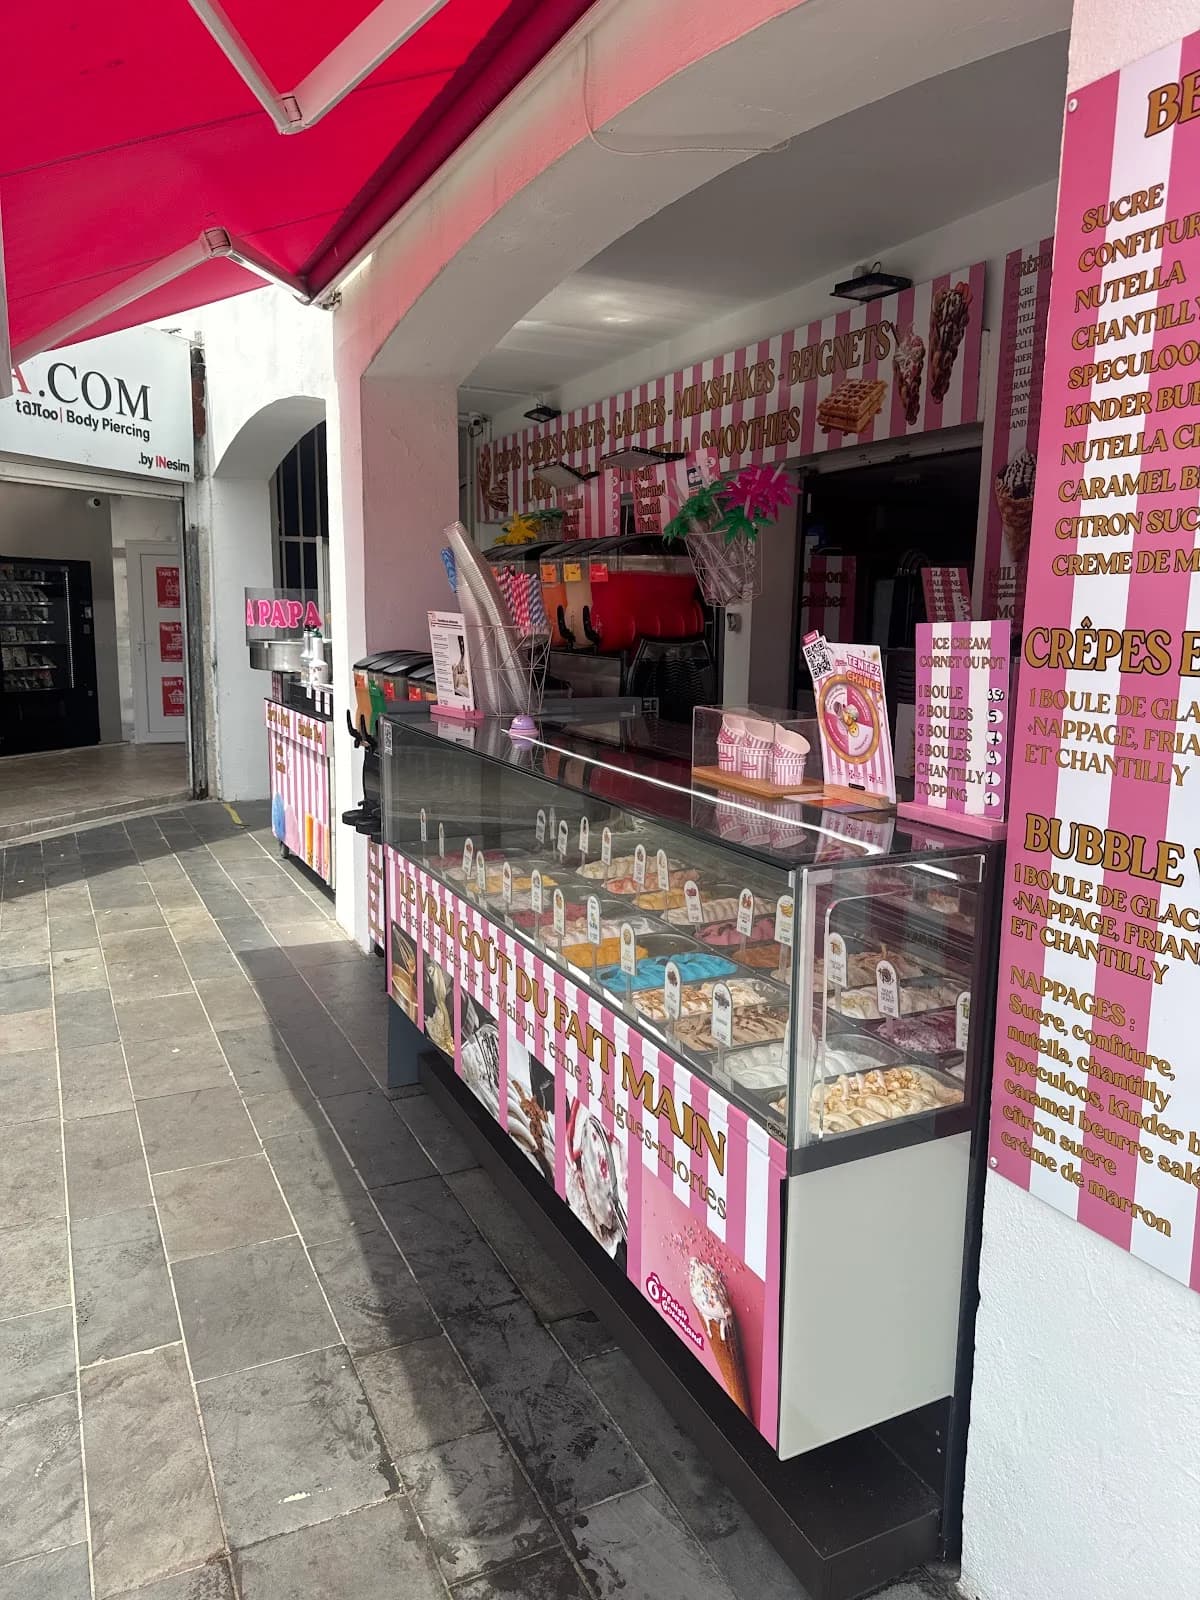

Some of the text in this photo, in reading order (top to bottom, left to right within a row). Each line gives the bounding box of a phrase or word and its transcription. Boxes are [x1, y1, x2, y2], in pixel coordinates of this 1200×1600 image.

[1081, 183, 1164, 233] SUCRE
[1074, 260, 1186, 313] NUTELLA
[1071, 296, 1200, 350] CHANTILL
[614, 396, 666, 440] GAUFRES
[674, 358, 775, 420] MILKSHAKES
[787, 320, 892, 386] BEIGNETS
[1068, 340, 1200, 389] SPECULOO
[67, 410, 99, 432] Body
[102, 418, 150, 442] Piercing
[1064, 391, 1152, 428] KINDER
[702, 406, 800, 458] SMOOTHIES
[1060, 429, 1168, 465] NUTELLA
[156, 455, 190, 472] INesim
[636, 480, 666, 499] Normal
[1058, 465, 1200, 502] CARAMEL B
[1055, 506, 1200, 540] CITRON SUC
[1052, 552, 1132, 576] CREME
[1136, 550, 1170, 574] DE
[258, 600, 322, 628] PAPA
[933, 638, 992, 650] ICE CREAM
[1024, 616, 1172, 676] CRÊPES
[846, 670, 880, 693] CHANCE
[847, 654, 880, 677] TENTEZ
[919, 656, 1006, 670] CORNET OU POT
[918, 684, 922, 698] 1
[924, 686, 963, 700] BOULE
[1030, 688, 1036, 707] 1
[1039, 688, 1110, 714] BOULE
[1115, 694, 1146, 718] DE
[918, 704, 997, 722] 2 BOULES 5
[916, 743, 924, 756] 4
[924, 744, 972, 762] BOULES
[918, 724, 1000, 744] 3 BOULES 7
[916, 762, 994, 785] CHANTILLY 1
[1025, 744, 1190, 786] ET CHANTILLY
[916, 782, 992, 806] TOPPING 1
[1024, 813, 1184, 887] BUBBLE
[1014, 863, 1200, 933] 1 BOULE DE GLAC
[1011, 916, 1170, 984] ET CHANTILLY
[400, 871, 416, 905] LE
[417, 885, 454, 940] VRAI
[458, 920, 512, 986] GOÛT
[516, 965, 549, 1018] DU
[554, 996, 616, 1074] FAIT
[622, 1052, 726, 1176] MAIN
[1009, 994, 1176, 1081] Sucre, confiture,
[1008, 1026, 1171, 1112] nutella, chantilly
[464, 962, 478, 986] par
[496, 985, 536, 1040] Maison
[538, 1022, 582, 1082] Terme
[586, 1068, 594, 1096] à
[600, 1080, 726, 1220] Aigues-mortes
[1004, 1079, 1074, 1125] caramel
[1078, 1110, 1154, 1164] beurre
[1002, 1105, 1116, 1176] citron sucre
[1001, 1132, 1172, 1238] crème de marron
